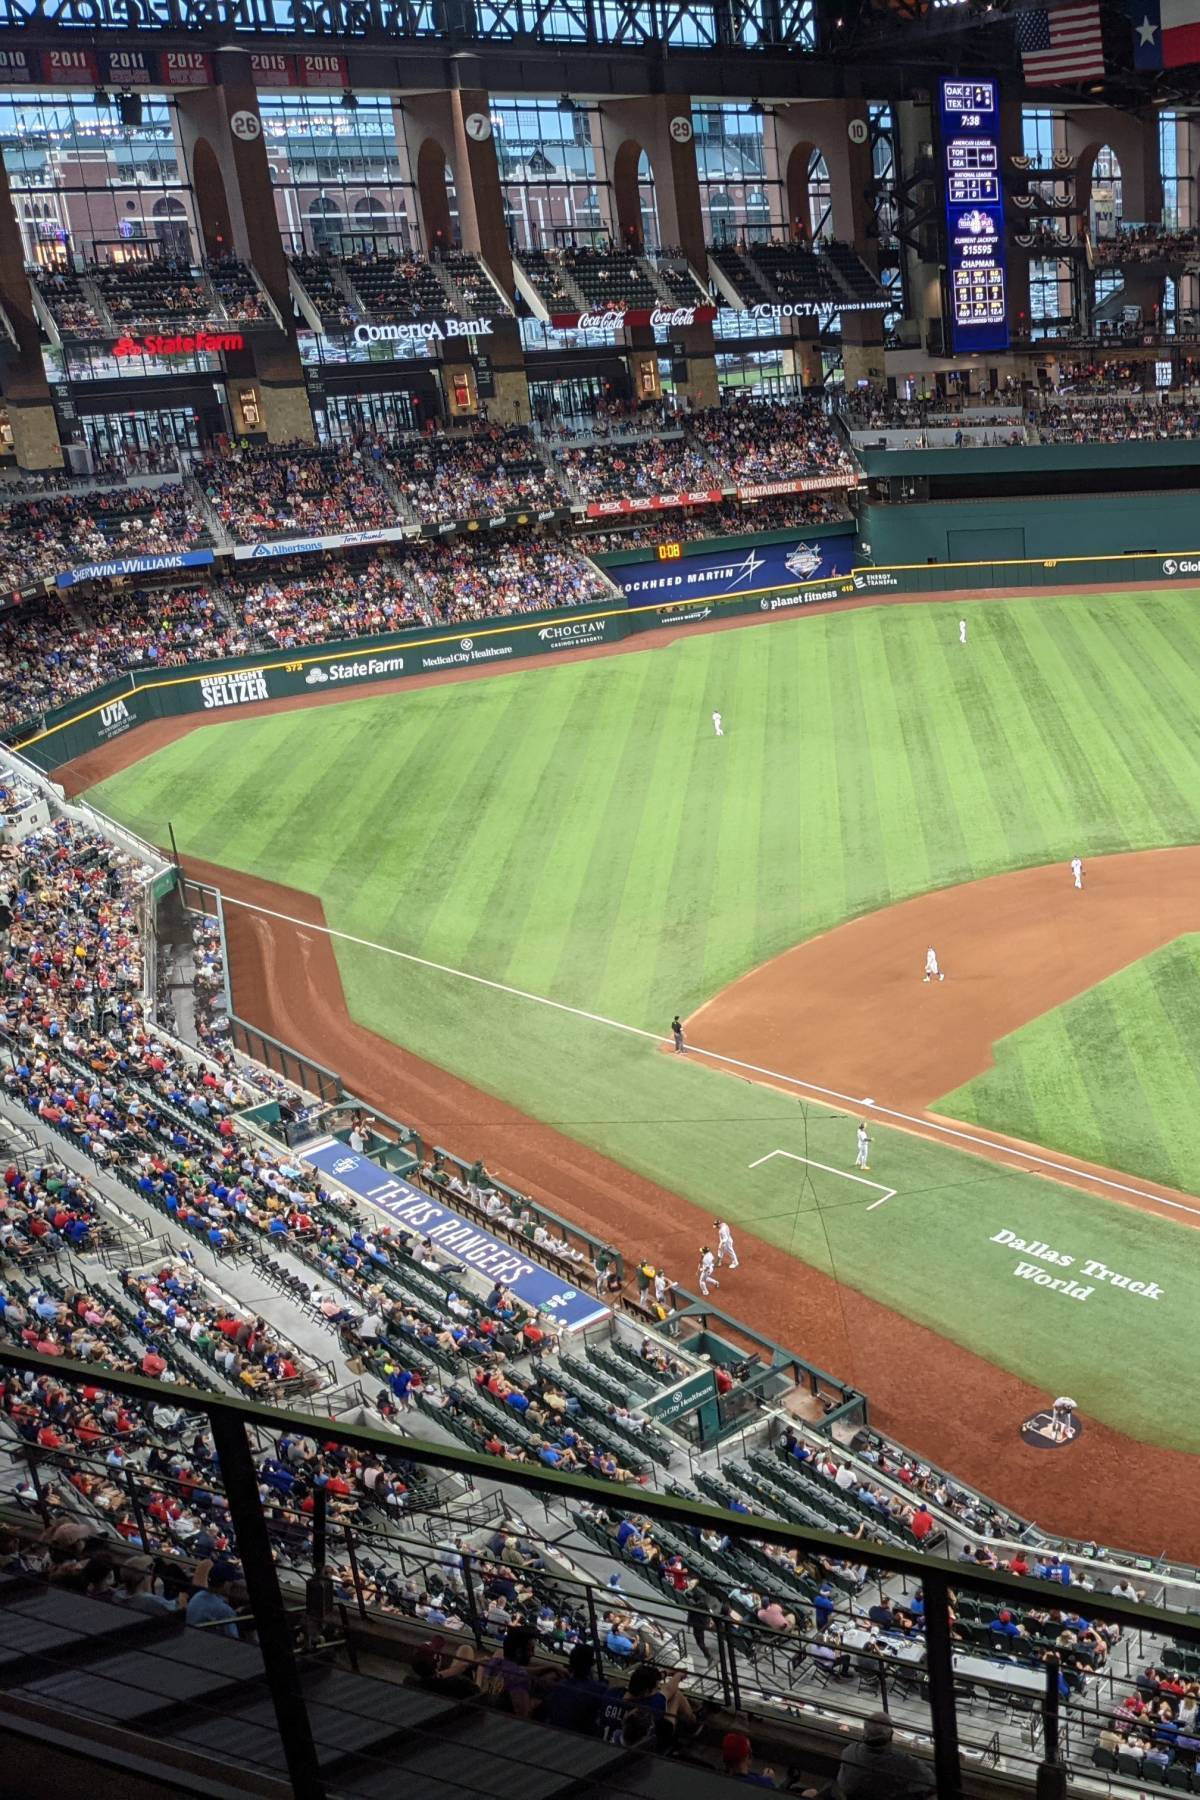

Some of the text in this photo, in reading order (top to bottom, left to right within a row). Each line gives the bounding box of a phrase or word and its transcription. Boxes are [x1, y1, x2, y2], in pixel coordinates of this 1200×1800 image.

[50, 52, 86, 67] 2011
[109, 53, 145, 68] 2011
[167, 53, 204, 69] 2012
[250, 55, 286, 70] 2015
[305, 56, 339, 71] 2016
[946, 87, 962, 95] OAK
[948, 100, 962, 108] TEX
[234, 117, 257, 134] 26
[473, 119, 483, 136] 7
[961, 115, 980, 126] 7:38
[672, 122, 690, 137] 29
[851, 124, 864, 139] 10
[962, 245, 992, 255] $15595
[961, 260, 995, 268] CHAPMAN
[760, 301, 834, 318] CHOCTAW
[834, 303, 859, 311] CASINOS
[865, 301, 892, 310] RESORTS
[445, 317, 494, 337] Bank
[740, 475, 856, 497] WHATABURGER WHATABURGER
[630, 498, 651, 508] DEX
[660, 495, 680, 504] DEX
[688, 491, 709, 500] DEX
[600, 501, 621, 511] DEX
[340, 530, 385, 545] Tom Thumb
[271, 541, 323, 556] Albertsons
[687, 568, 734, 583] MARTIN
[770, 588, 838, 609] planet fitness
[546, 620, 606, 640] CHOCTAW
[551, 640, 575, 649] CASINOS
[422, 645, 513, 668] Medical City Healthcare
[285, 662, 304, 673] 372
[200, 669, 264, 688] BUD LIGHT
[202, 677, 269, 709] SELTZER
[100, 699, 129, 727] UTA
[366, 1180, 534, 1285] TEXAS RANGERS
[989, 1228, 1165, 1300] Dallas Truck
[1012, 1261, 1096, 1301] World
[680, 1385, 714, 1408] Healthcare
